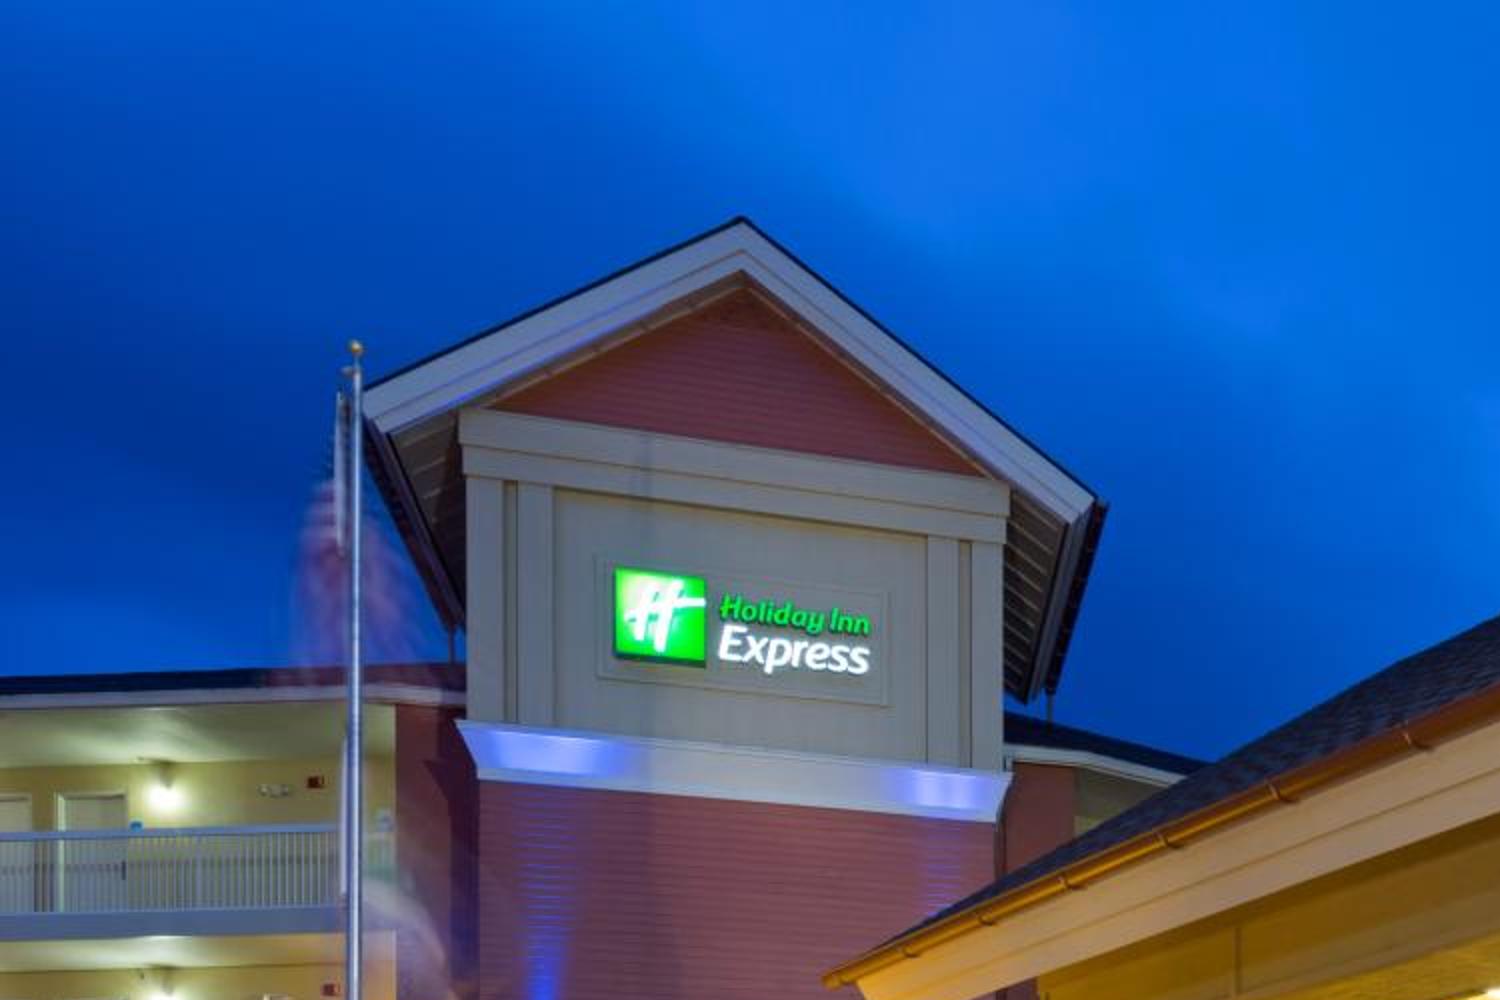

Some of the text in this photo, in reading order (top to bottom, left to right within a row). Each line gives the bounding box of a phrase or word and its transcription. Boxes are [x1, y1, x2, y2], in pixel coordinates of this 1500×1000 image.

[719, 593, 871, 635] Holiday Inn
[718, 625, 871, 675] Express
